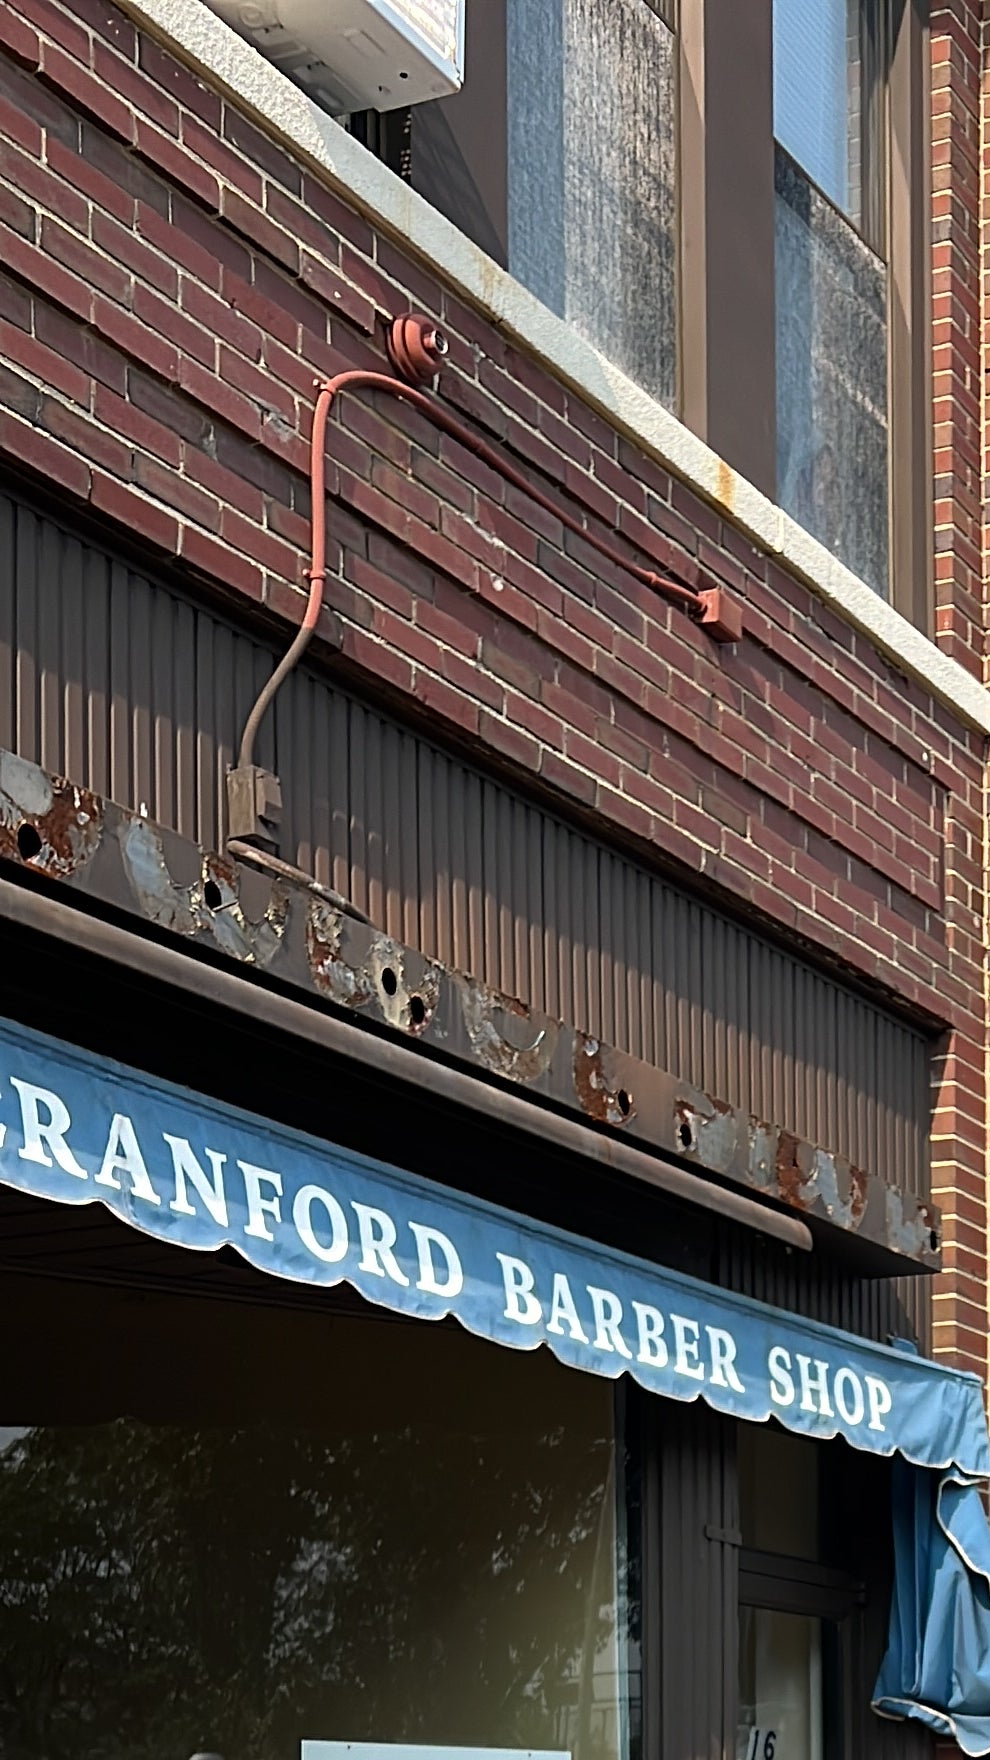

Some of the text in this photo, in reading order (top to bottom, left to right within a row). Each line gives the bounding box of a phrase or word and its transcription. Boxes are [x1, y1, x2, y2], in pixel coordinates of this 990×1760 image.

[0, 1076, 893, 1432] RANFORD BARBER SHOP
